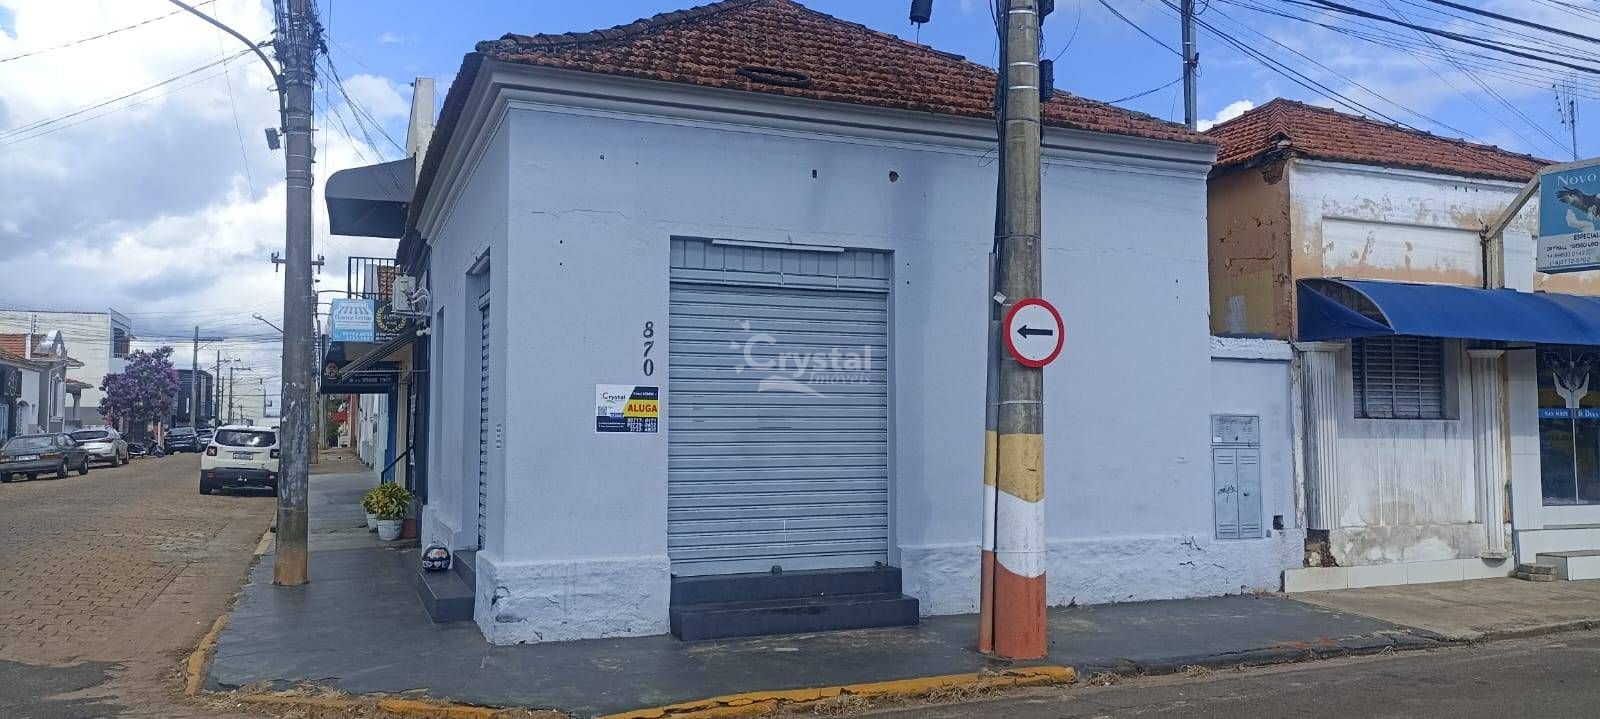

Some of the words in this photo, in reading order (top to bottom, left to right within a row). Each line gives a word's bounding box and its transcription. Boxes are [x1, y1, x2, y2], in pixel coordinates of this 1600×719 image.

[643, 321, 654, 376] 870
[602, 392, 625, 400] Crystal
[627, 404, 658, 413] ALUGA
